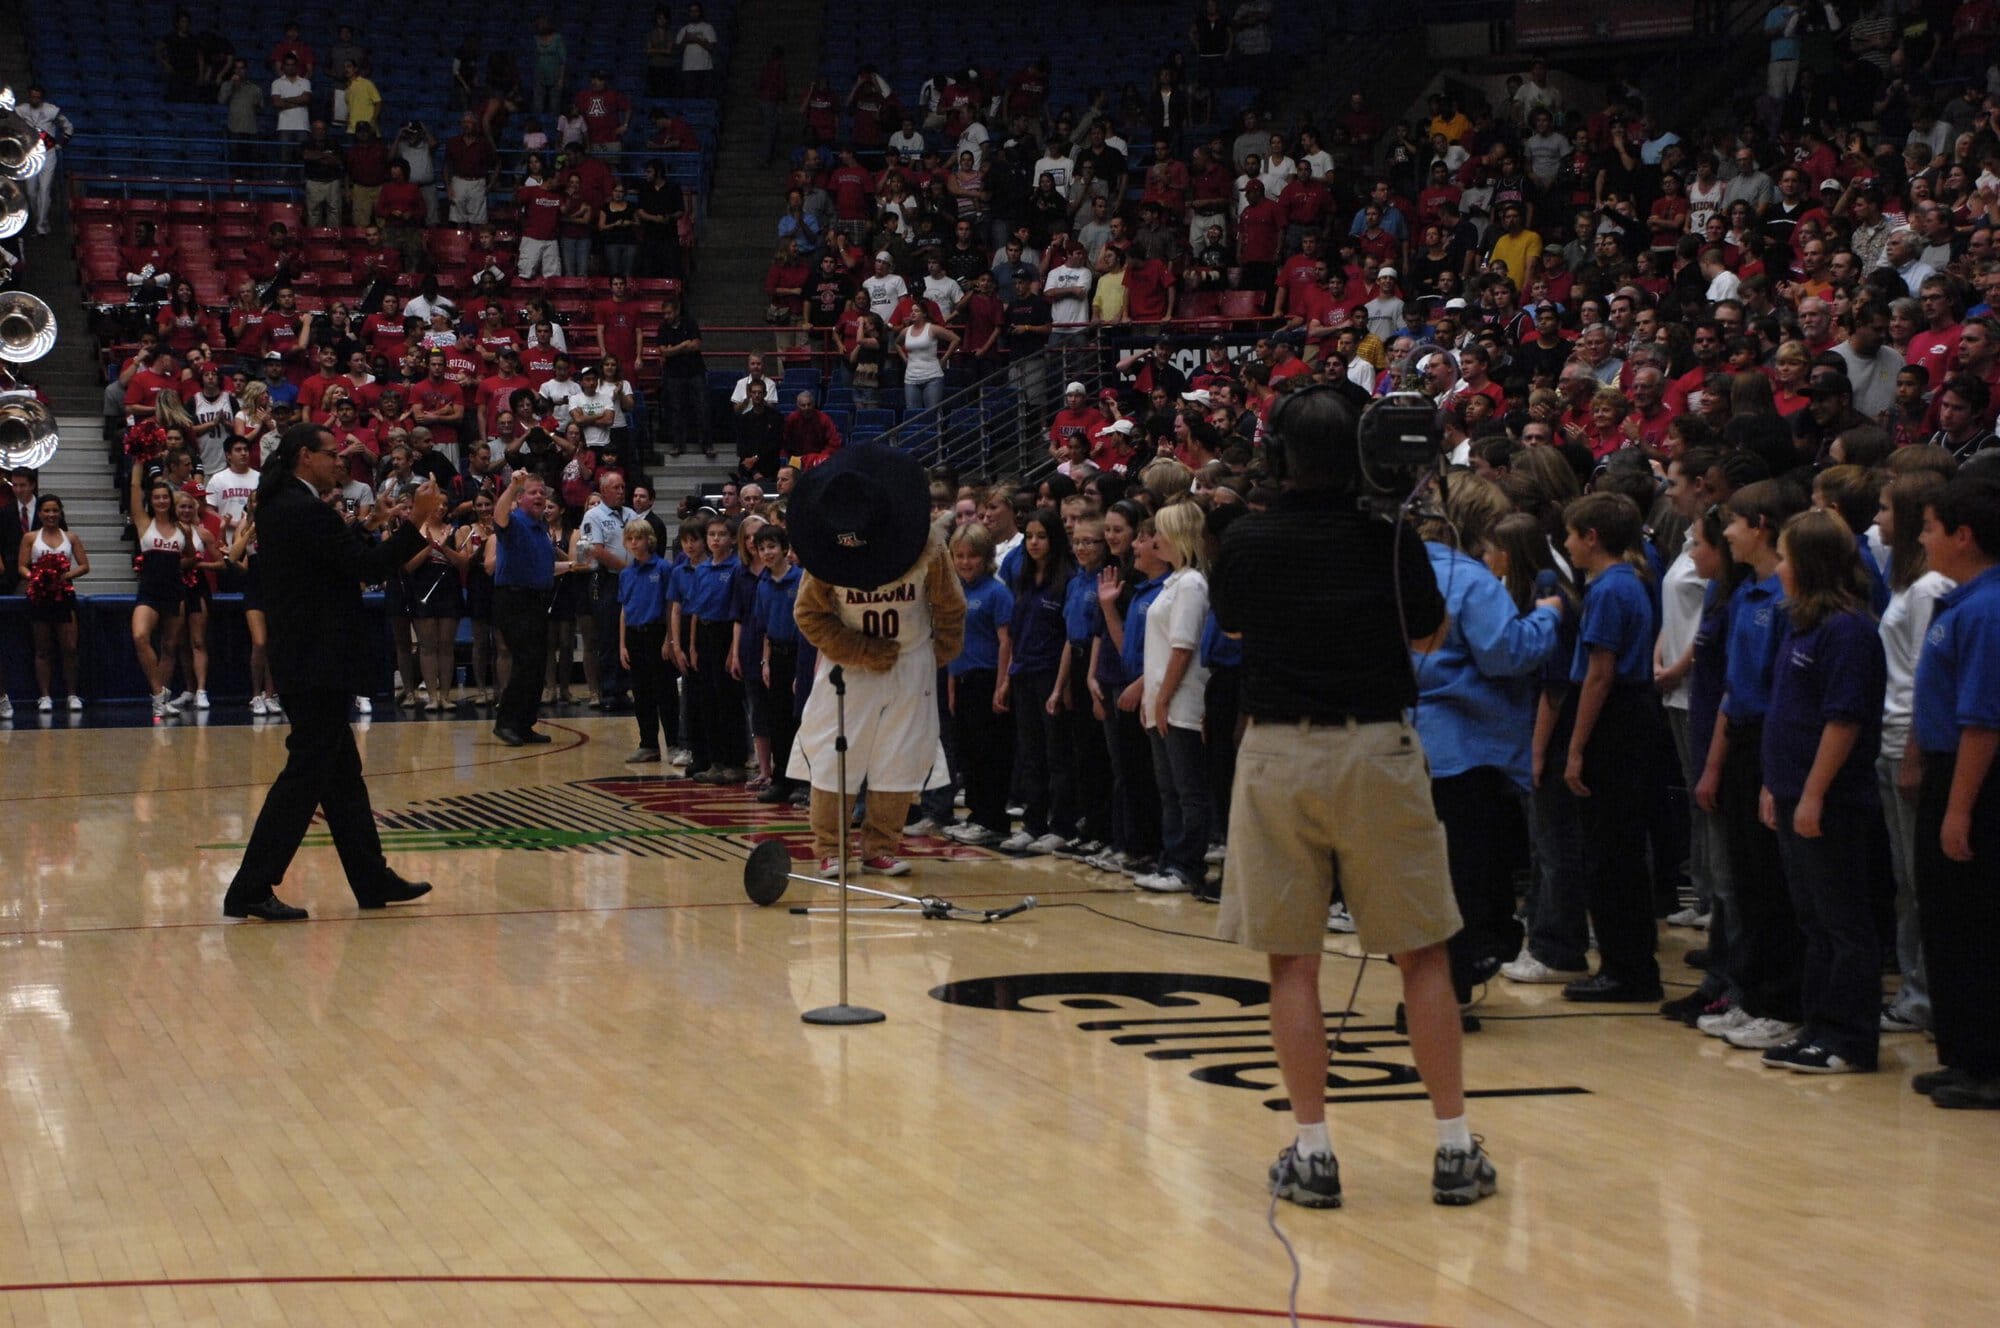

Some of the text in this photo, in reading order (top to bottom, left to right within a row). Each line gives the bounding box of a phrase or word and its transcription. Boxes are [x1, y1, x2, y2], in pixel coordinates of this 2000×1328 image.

[588, 98, 606, 117] A
[1698, 213, 1705, 228] 3
[863, 609, 899, 638] 00
